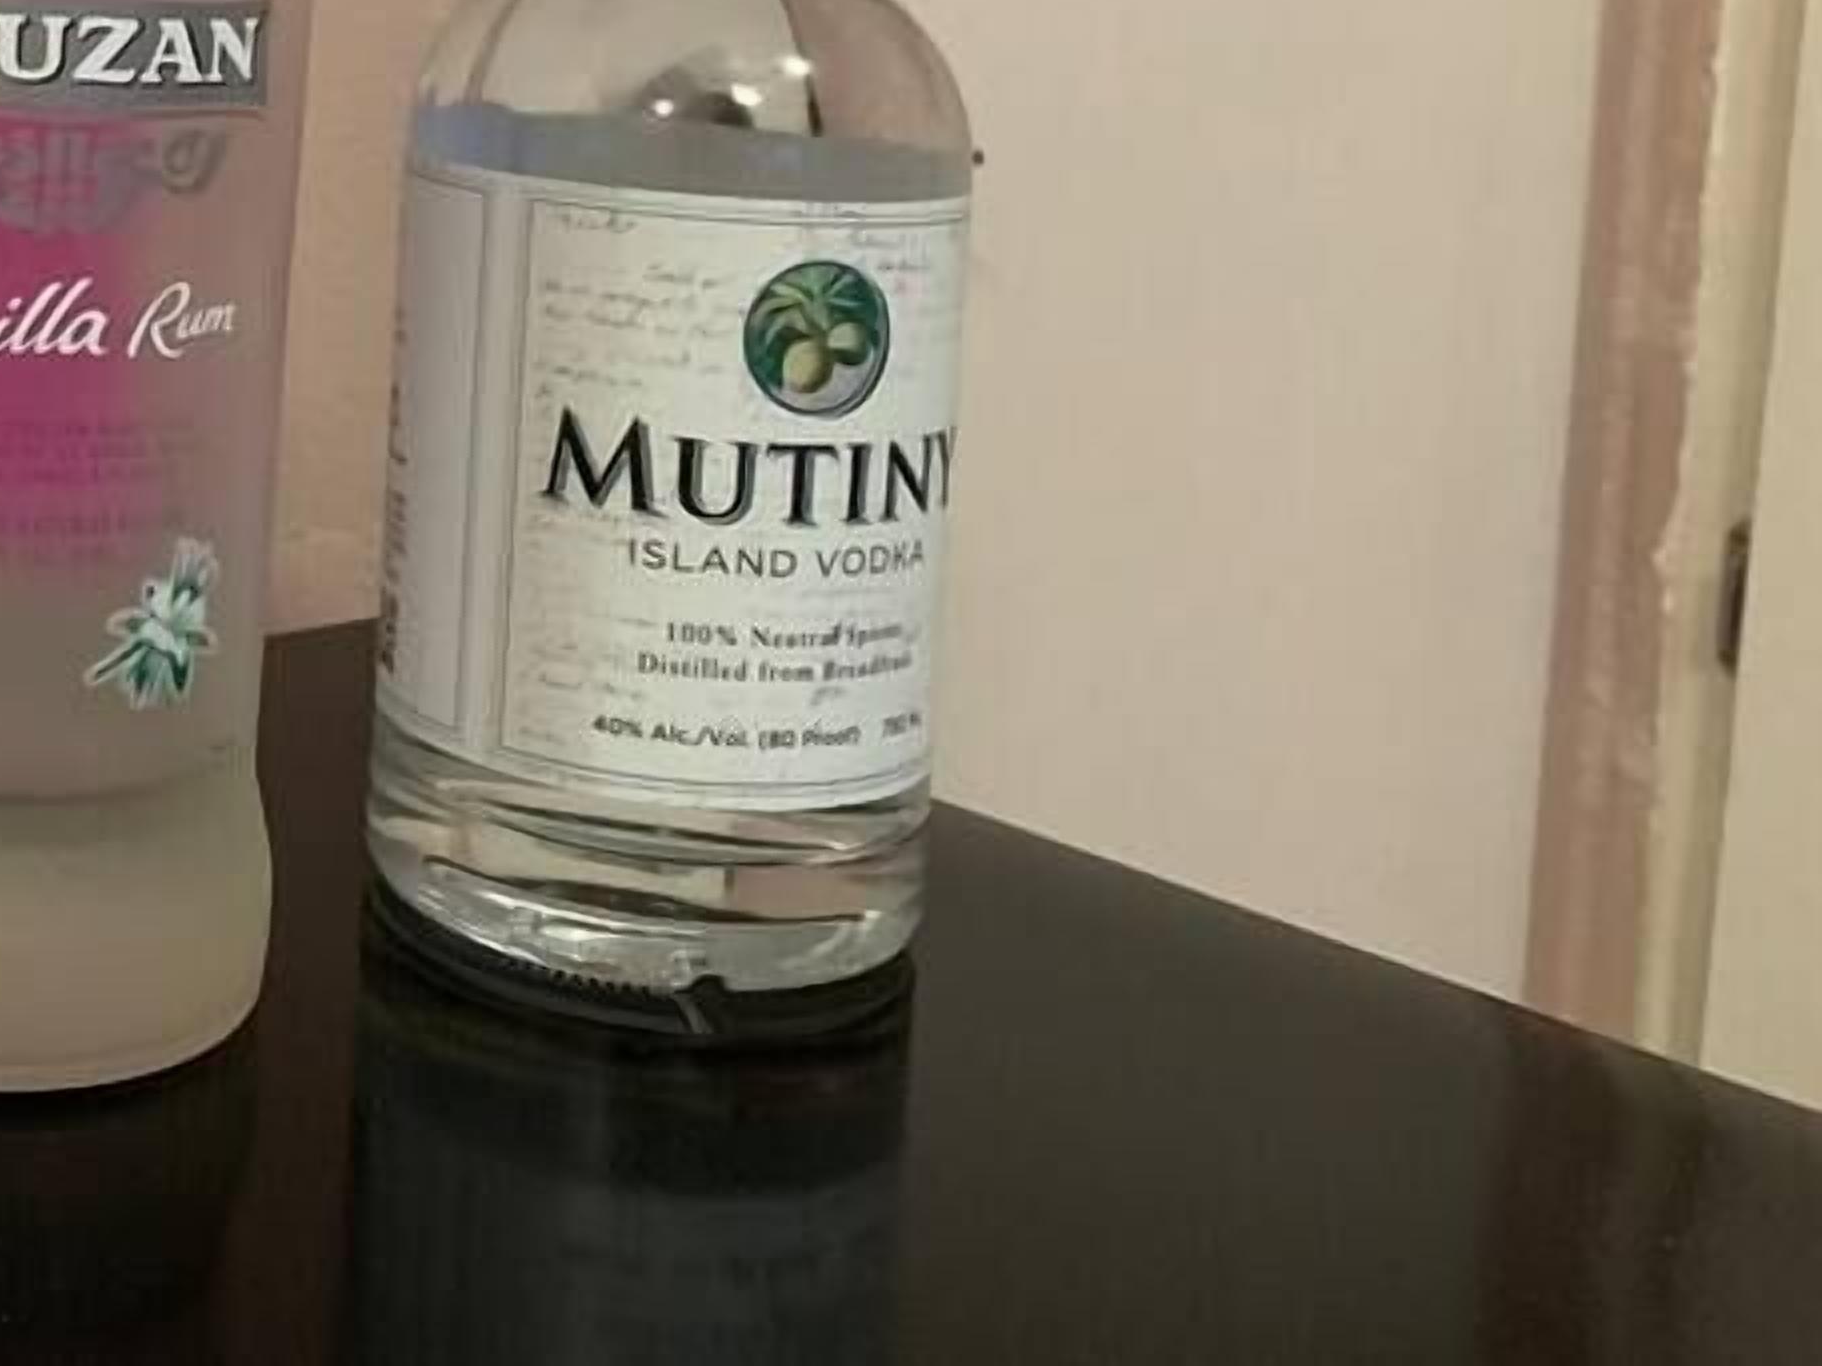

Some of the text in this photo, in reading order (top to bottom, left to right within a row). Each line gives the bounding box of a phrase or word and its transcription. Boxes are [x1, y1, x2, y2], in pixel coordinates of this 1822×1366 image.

[126, 280, 236, 360] Rum
[536, 404, 958, 527] MUTINY
[627, 536, 925, 580] ISLAND VODKA
[666, 620, 738, 647] 100%
